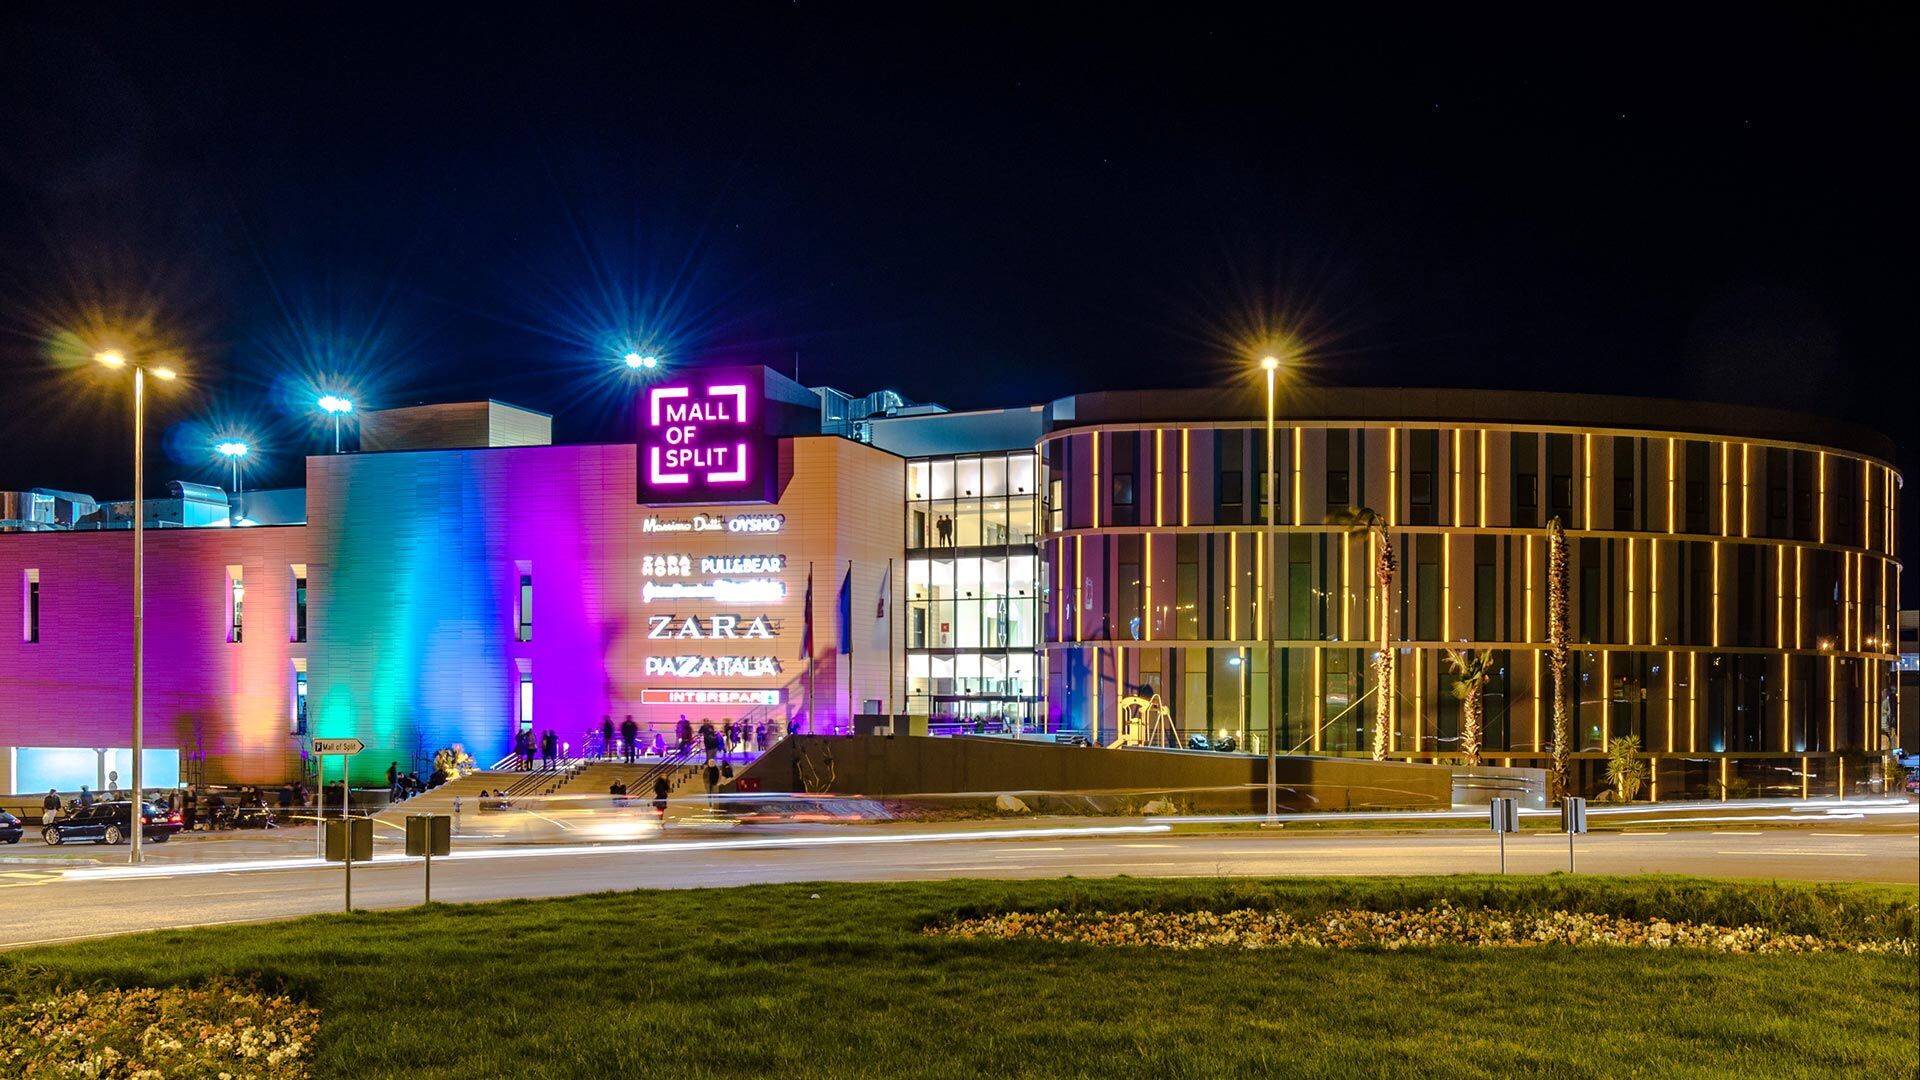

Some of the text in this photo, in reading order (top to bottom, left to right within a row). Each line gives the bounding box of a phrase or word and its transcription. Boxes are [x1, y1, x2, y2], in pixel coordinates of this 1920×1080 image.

[666, 402, 730, 422] MALL
[666, 426, 697, 445] OF
[665, 447, 728, 468] SPLIT
[642, 518, 692, 532] Massimo
[728, 518, 780, 532] OYSHO
[642, 556, 691, 566] ZARA
[701, 557, 781, 574] PULL&BEAR
[647, 616, 774, 639] ZARA
[669, 692, 761, 703] INTERSPAR
[336, 743, 342, 751] of
[343, 743, 356, 751] Split
